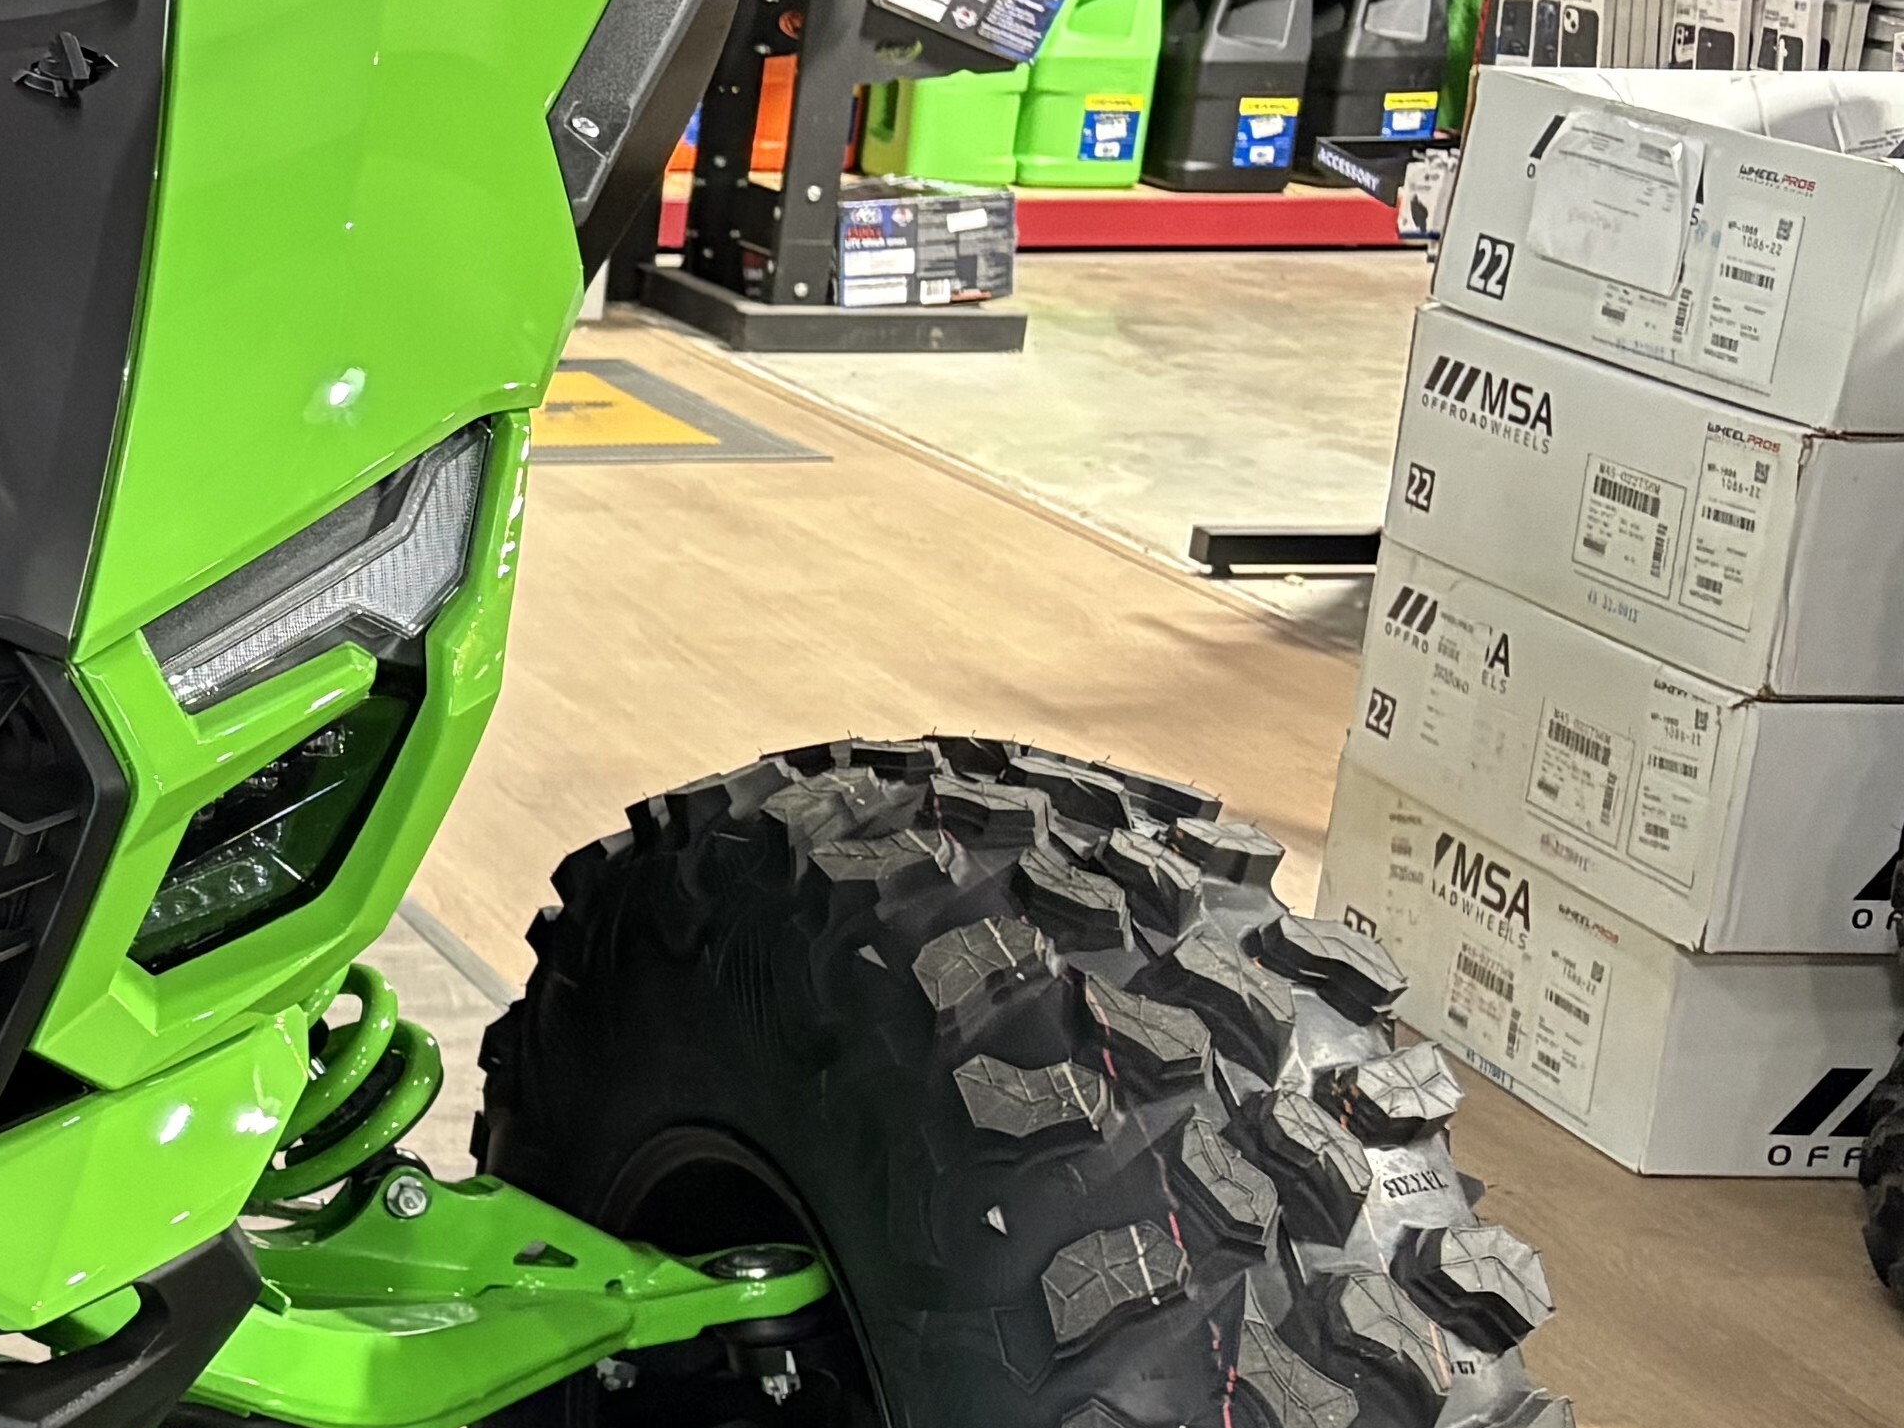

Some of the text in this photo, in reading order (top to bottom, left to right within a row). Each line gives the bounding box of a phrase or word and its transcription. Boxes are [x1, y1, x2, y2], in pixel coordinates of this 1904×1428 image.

[1317, 146, 1382, 192] ACCESSORY
[1739, 164, 1816, 192] WHEEL PROS
[1470, 236, 1509, 298] 22
[1421, 393, 1551, 455] OFFROAD WHEELS
[1480, 371, 1553, 438] MSA
[1707, 421, 1782, 454] WHEEL PROS
[1406, 465, 1432, 507] 22
[1384, 621, 1430, 655] OFFRO
[1481, 669, 1508, 695] ELS
[1367, 691, 1393, 734] 22
[1450, 841, 1531, 932] MSA
[1461, 897, 1528, 951] WHEELS
